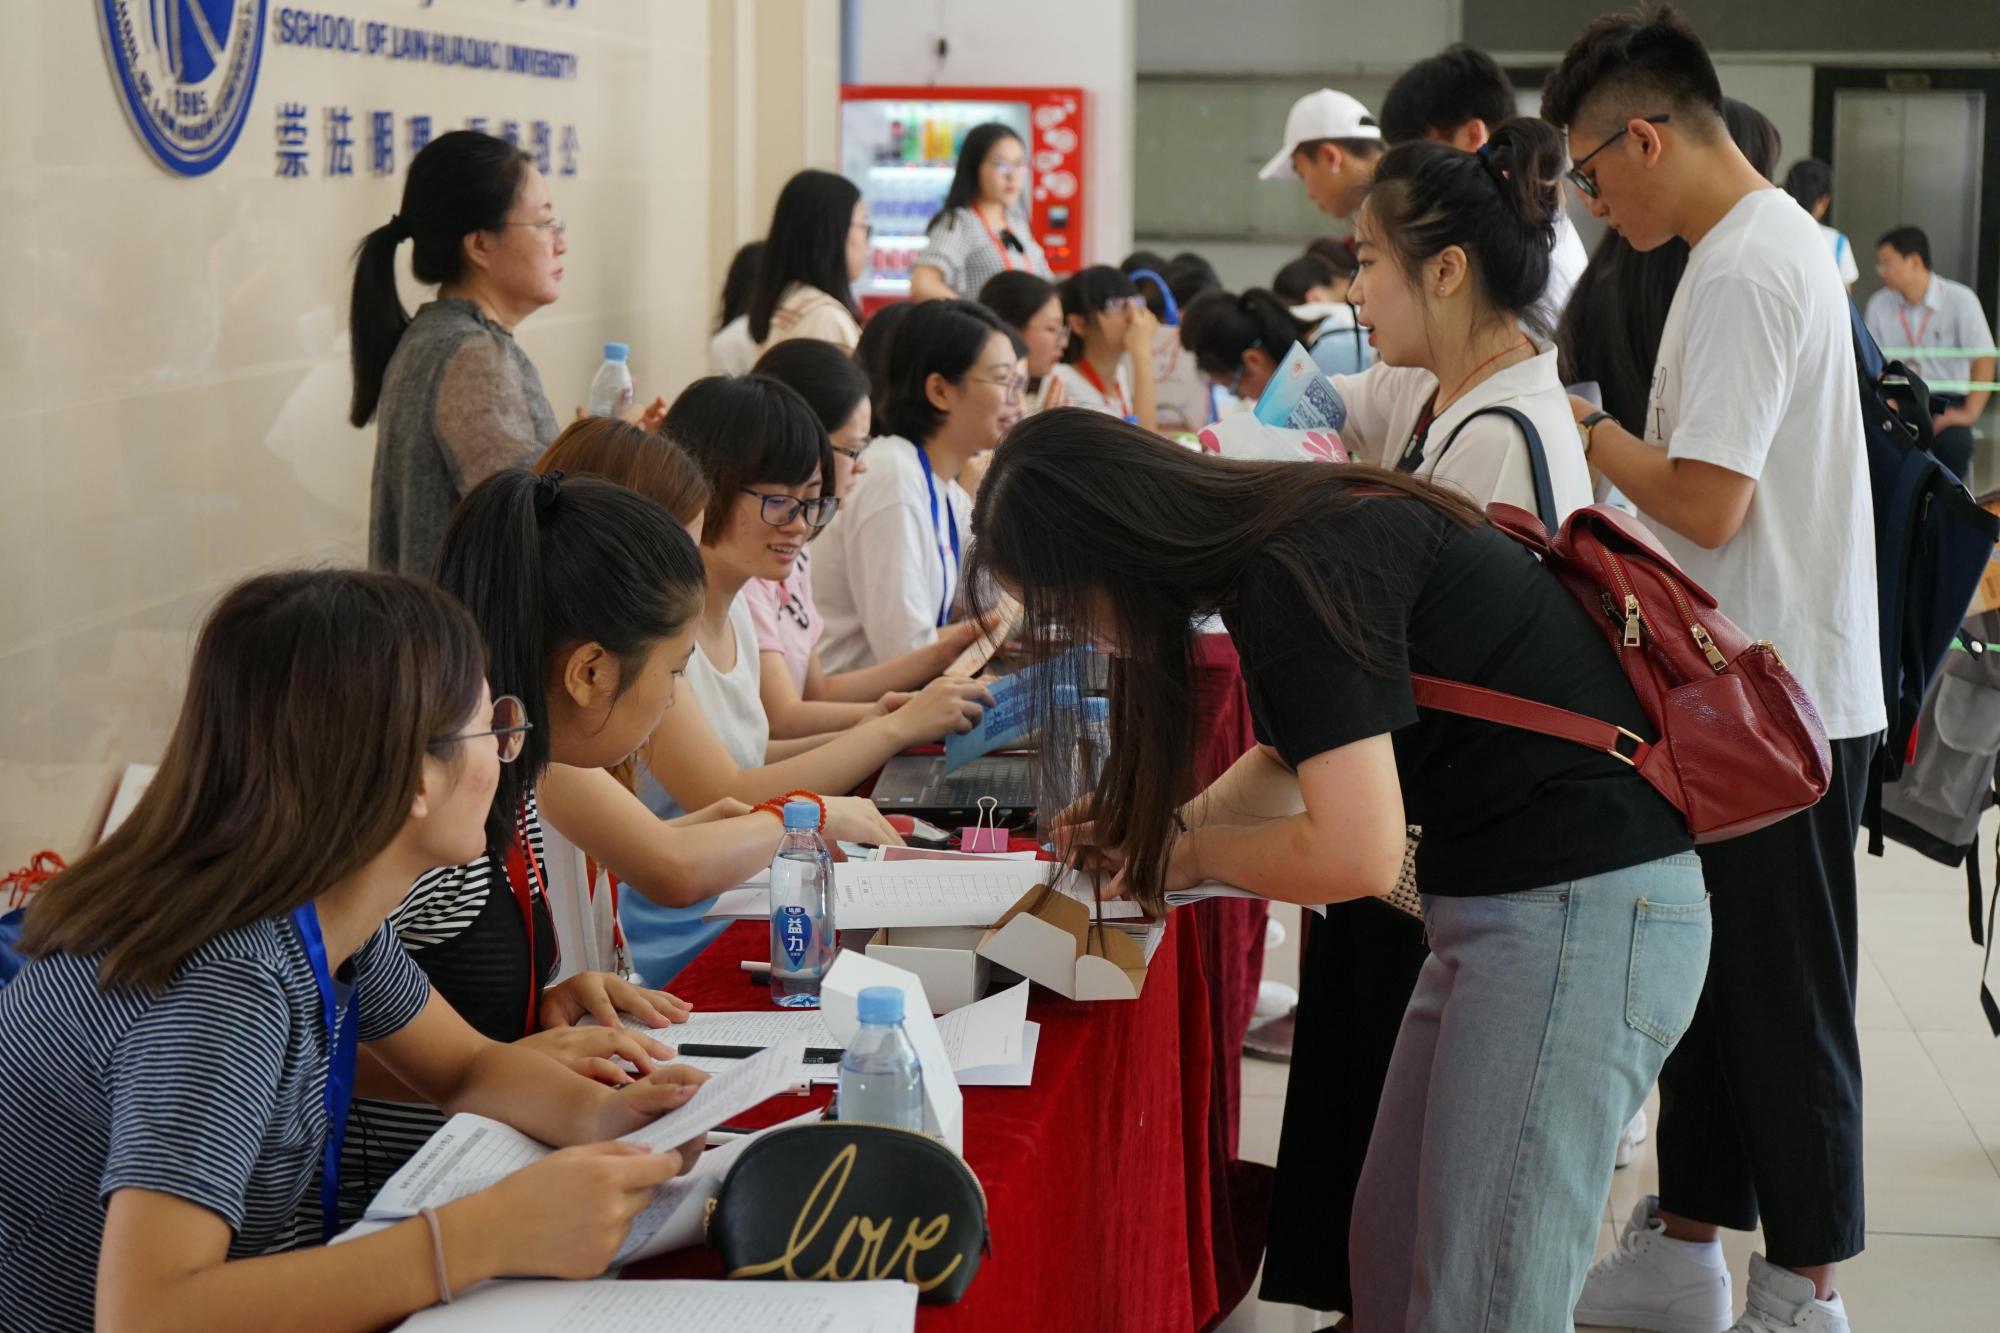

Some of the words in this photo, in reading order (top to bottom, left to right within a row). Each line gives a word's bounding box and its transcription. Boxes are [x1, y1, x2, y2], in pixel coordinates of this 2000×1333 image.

[279, 8, 360, 54] SCHOOL
[365, 22, 387, 56] OF
[788, 917, 803, 951] 益力
[729, 1143, 962, 1292] love
